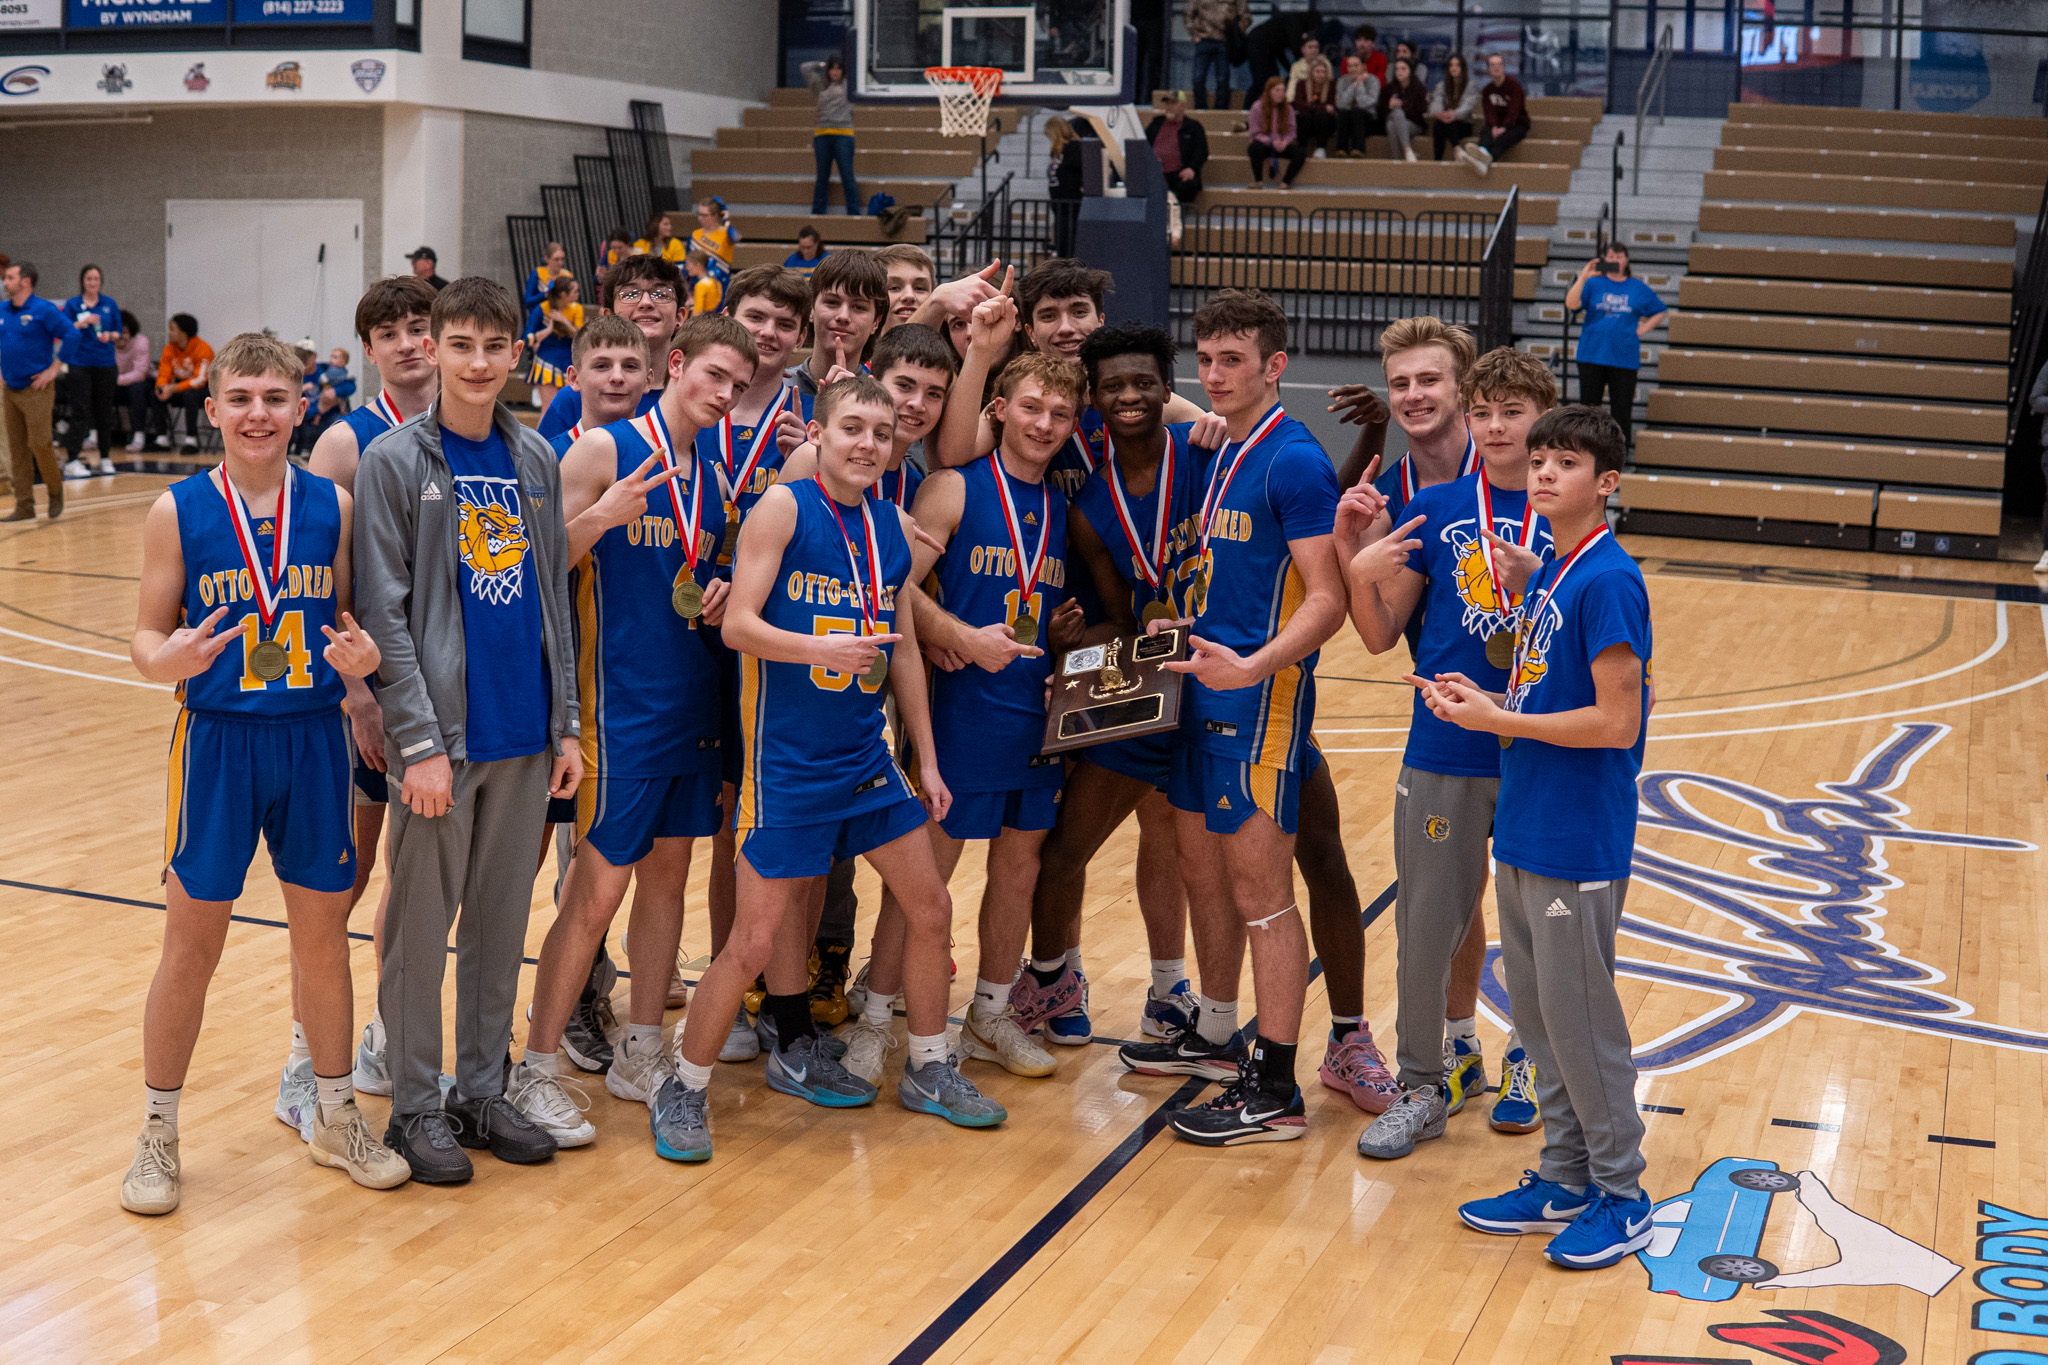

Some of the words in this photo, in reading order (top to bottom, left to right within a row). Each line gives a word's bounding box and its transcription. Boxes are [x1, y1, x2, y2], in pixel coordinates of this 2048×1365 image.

[100, 12, 118, 25] BY
[121, 10, 192, 24] WYNDHAM
[263, 1, 292, 16] (814)
[293, 1, 345, 14] 227-2223
[199, 565, 333, 607] OTTODRED
[238, 610, 314, 692] 14
[1545, 909, 1571, 917] adidas
[1971, 1199, 2048, 1338] BODY
